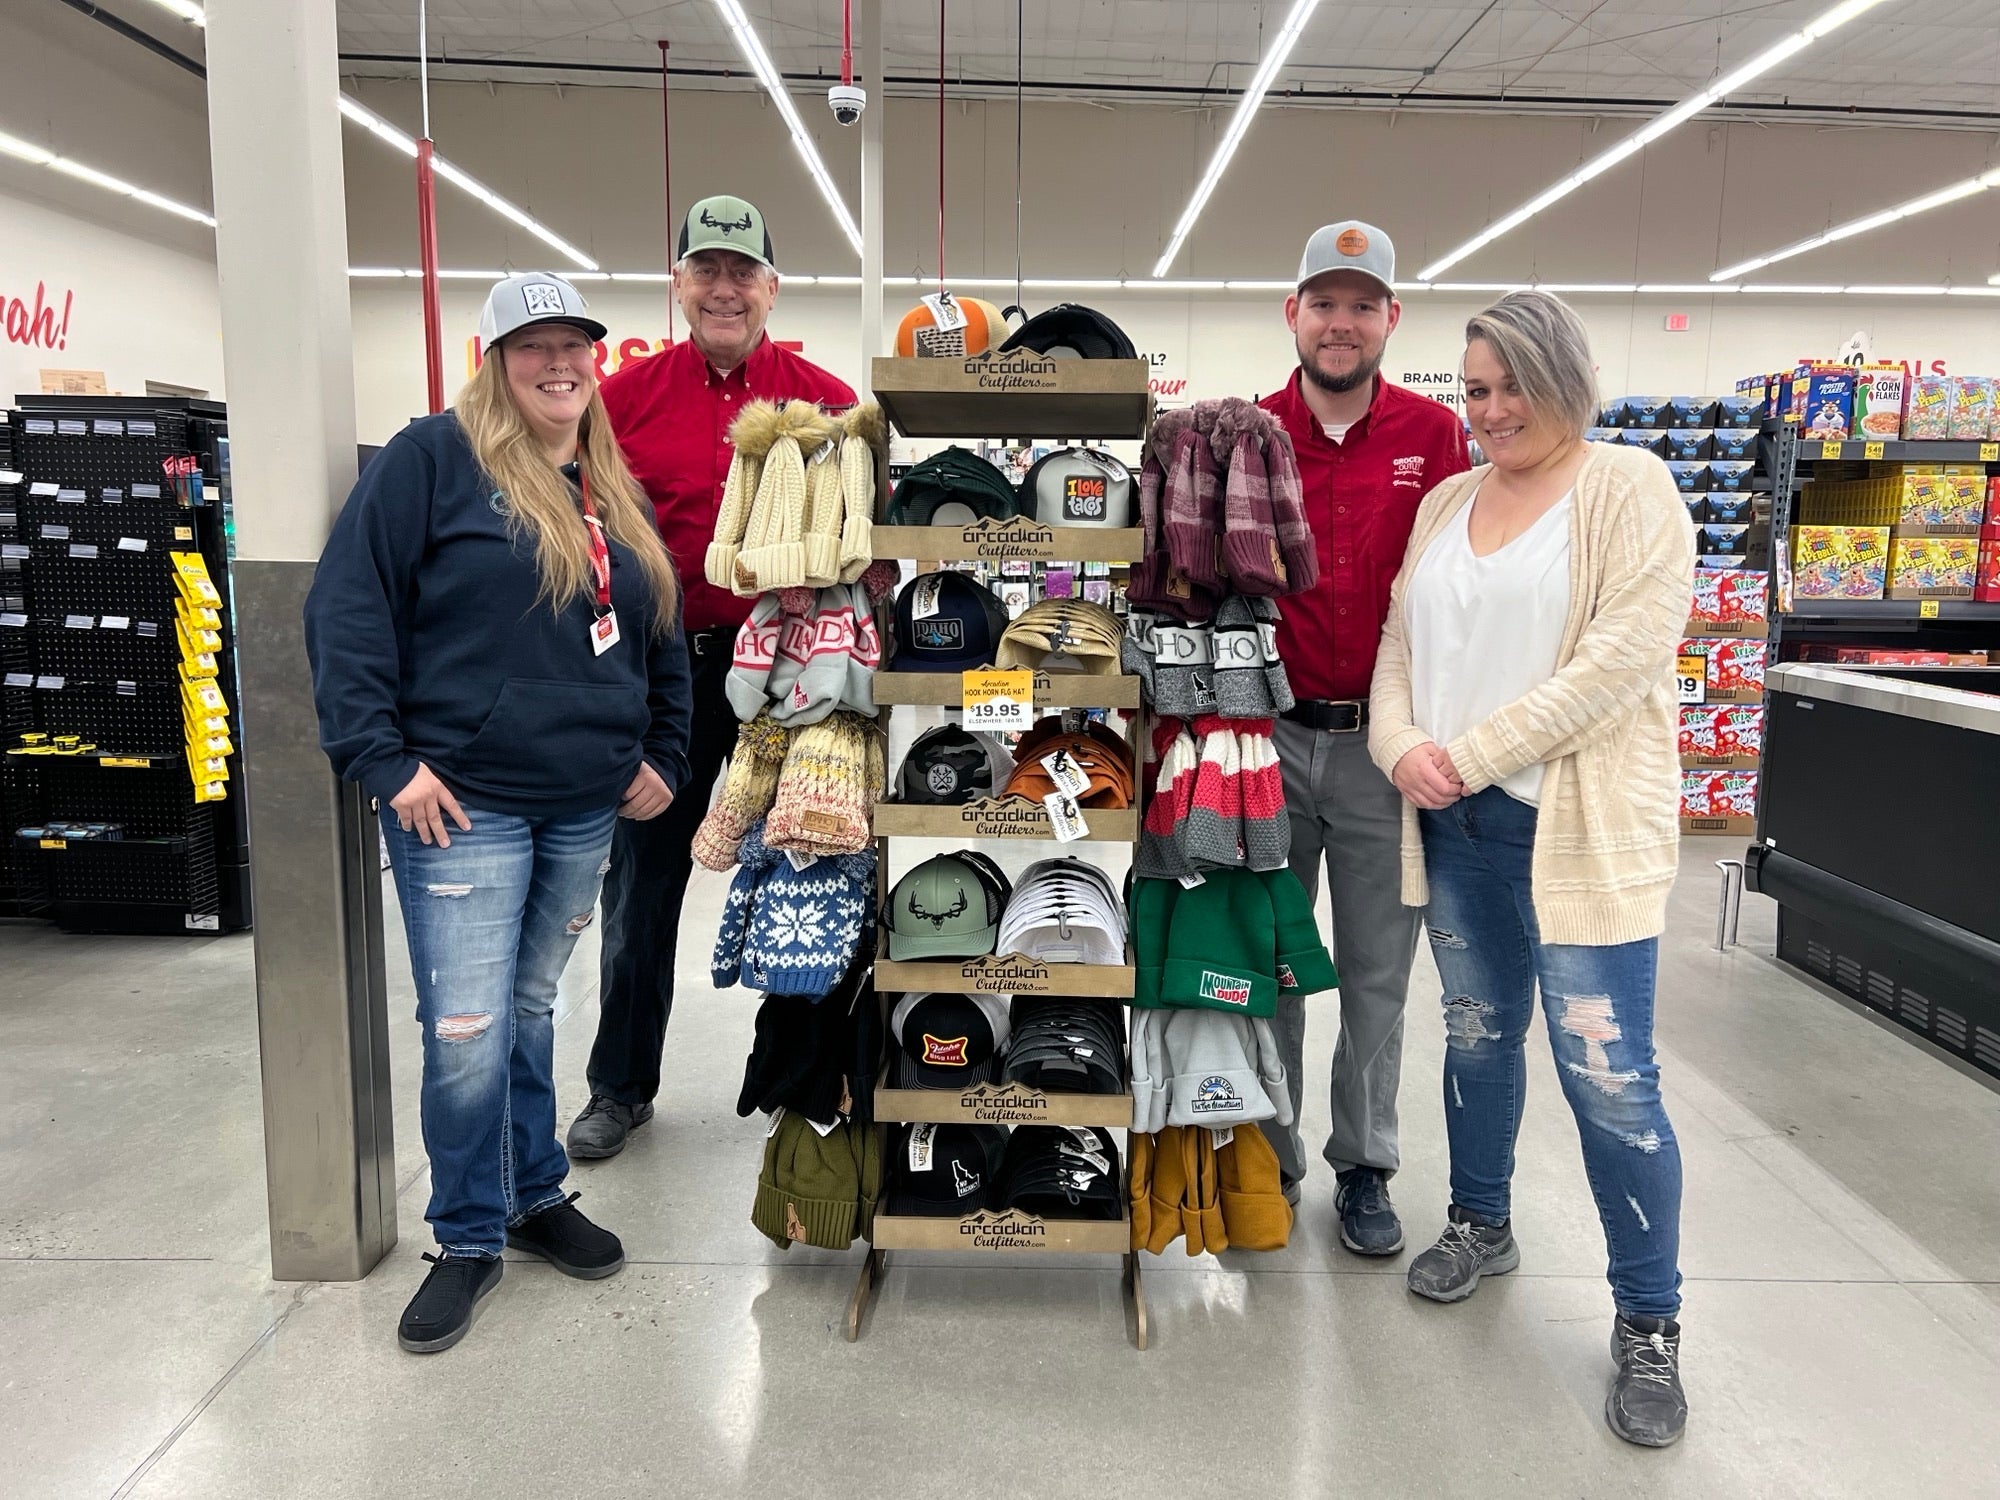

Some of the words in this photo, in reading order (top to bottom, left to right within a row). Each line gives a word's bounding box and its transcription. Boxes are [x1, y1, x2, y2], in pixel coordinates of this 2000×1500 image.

[964, 359, 1056, 374] arcadian
[1403, 373, 1453, 383] BRAND
[1876, 382, 1901, 392] CORN
[1875, 392, 1900, 401] FLAKES
[1068, 480, 1078, 496] I
[963, 528, 1053, 543] arcadian
[1734, 576, 1758, 590] Trix
[915, 622, 959, 638] IDAHO
[1686, 642, 1710, 654] Trix
[1732, 644, 1756, 657] Trix
[983, 688, 998, 696] HORN
[970, 704, 1020, 716] $19.95
[1684, 709, 1708, 723] Trix
[1728, 710, 1752, 723] Trix
[1722, 776, 1746, 790] Trix
[962, 808, 1049, 822] arcadian
[962, 966, 1048, 979] arcadian
[960, 1094, 1047, 1109] arcadian
[960, 1221, 1046, 1236] arcadian
